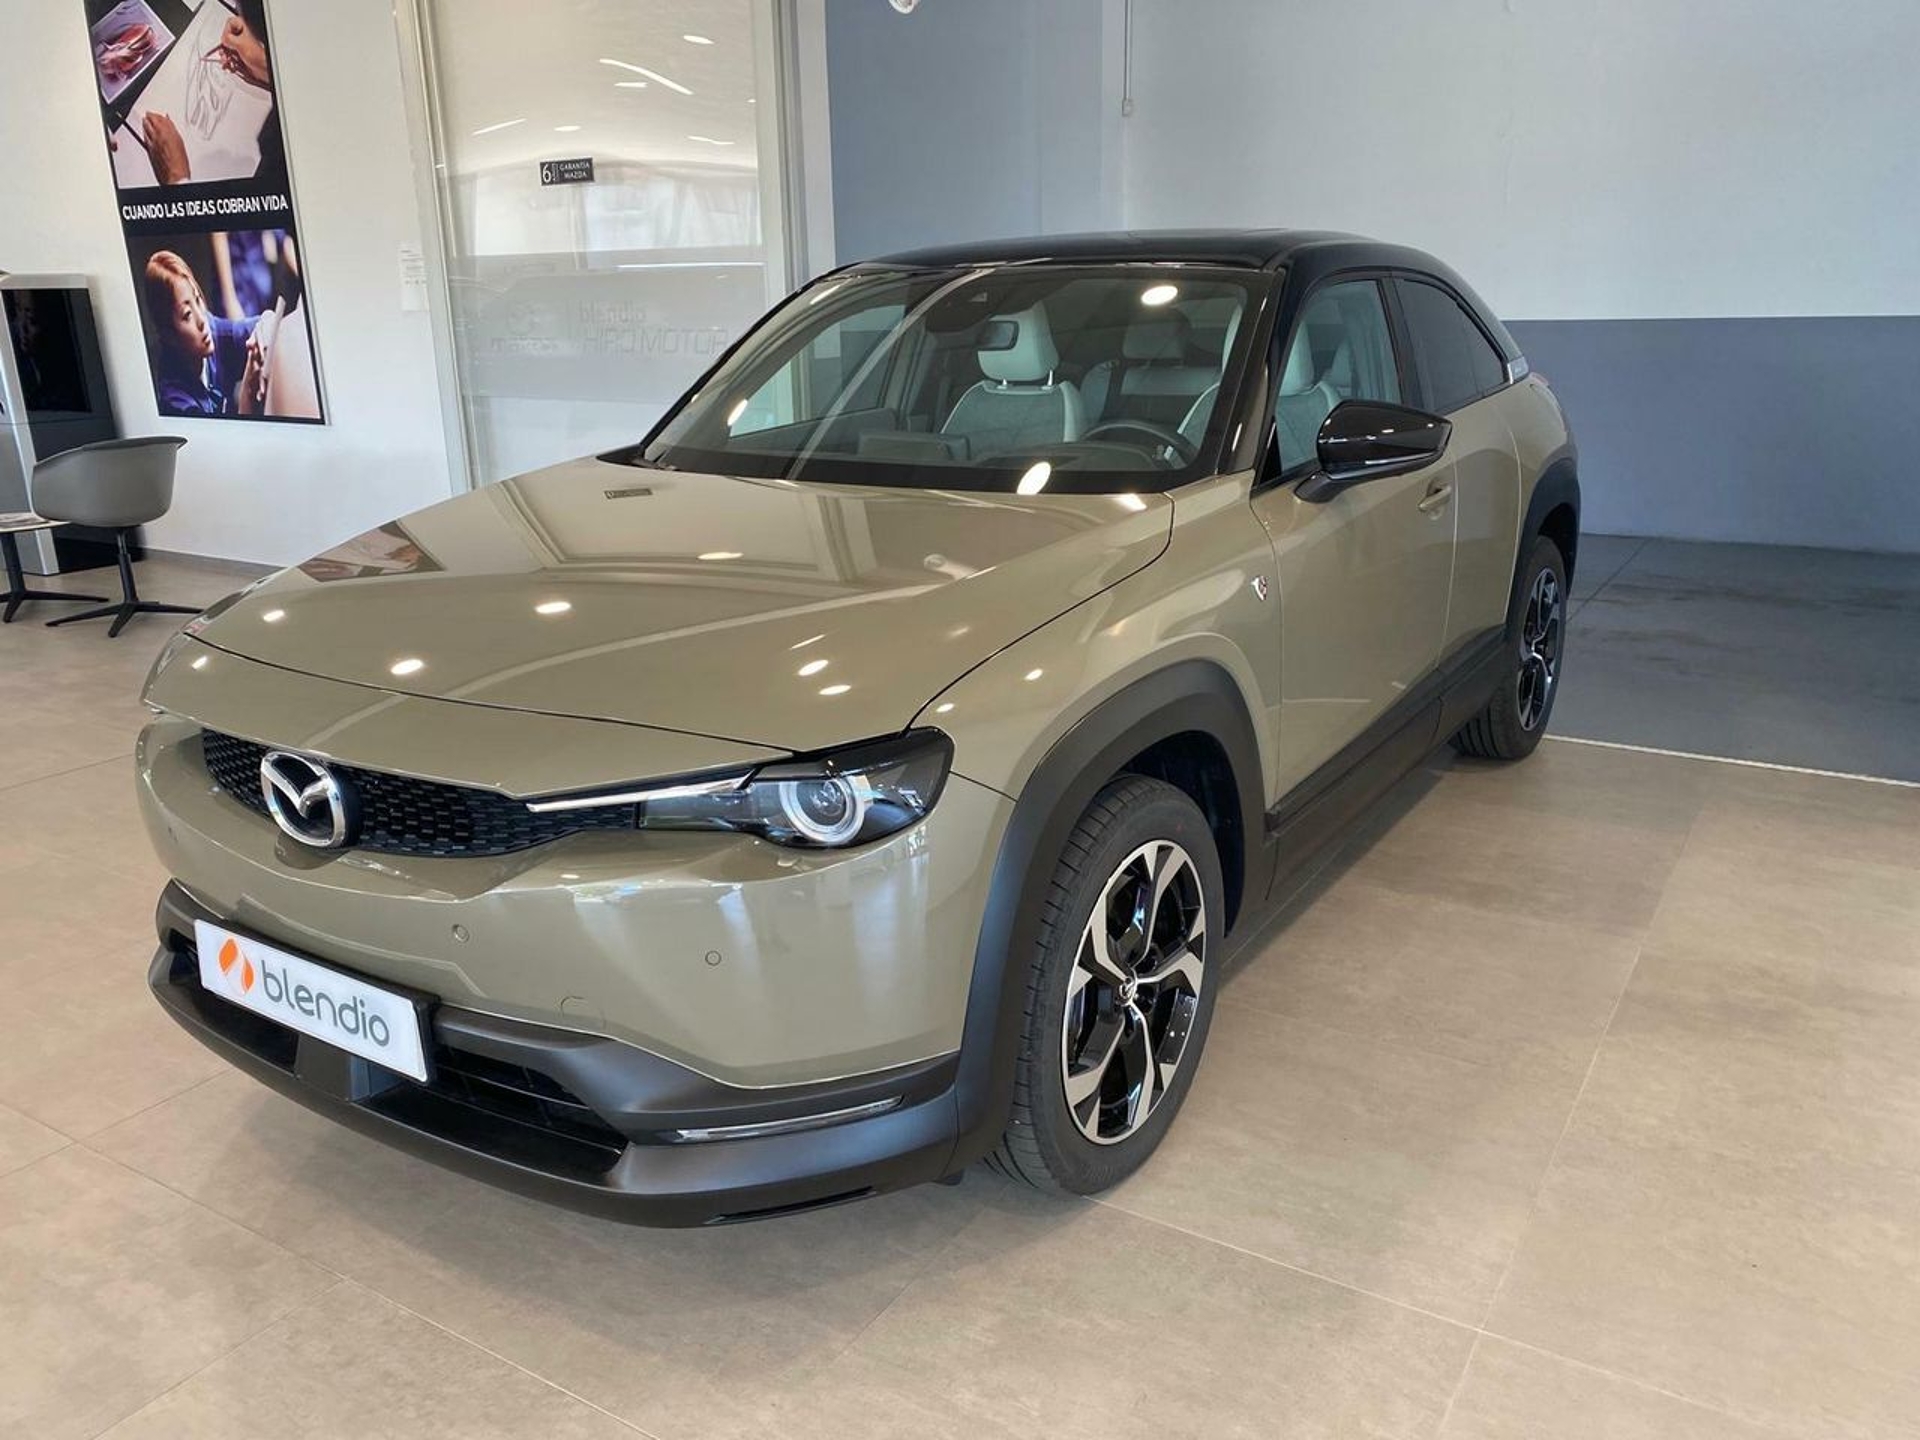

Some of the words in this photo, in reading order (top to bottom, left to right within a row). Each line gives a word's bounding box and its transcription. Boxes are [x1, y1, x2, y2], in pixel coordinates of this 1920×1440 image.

[543, 163, 551, 183] 6
[122, 204, 164, 220] CUANDO
[165, 203, 185, 217] LAS
[186, 200, 216, 216] IDEAS
[217, 196, 260, 214] COBRAN
[261, 194, 288, 211] VIDA
[261, 959, 390, 1048] blendio
